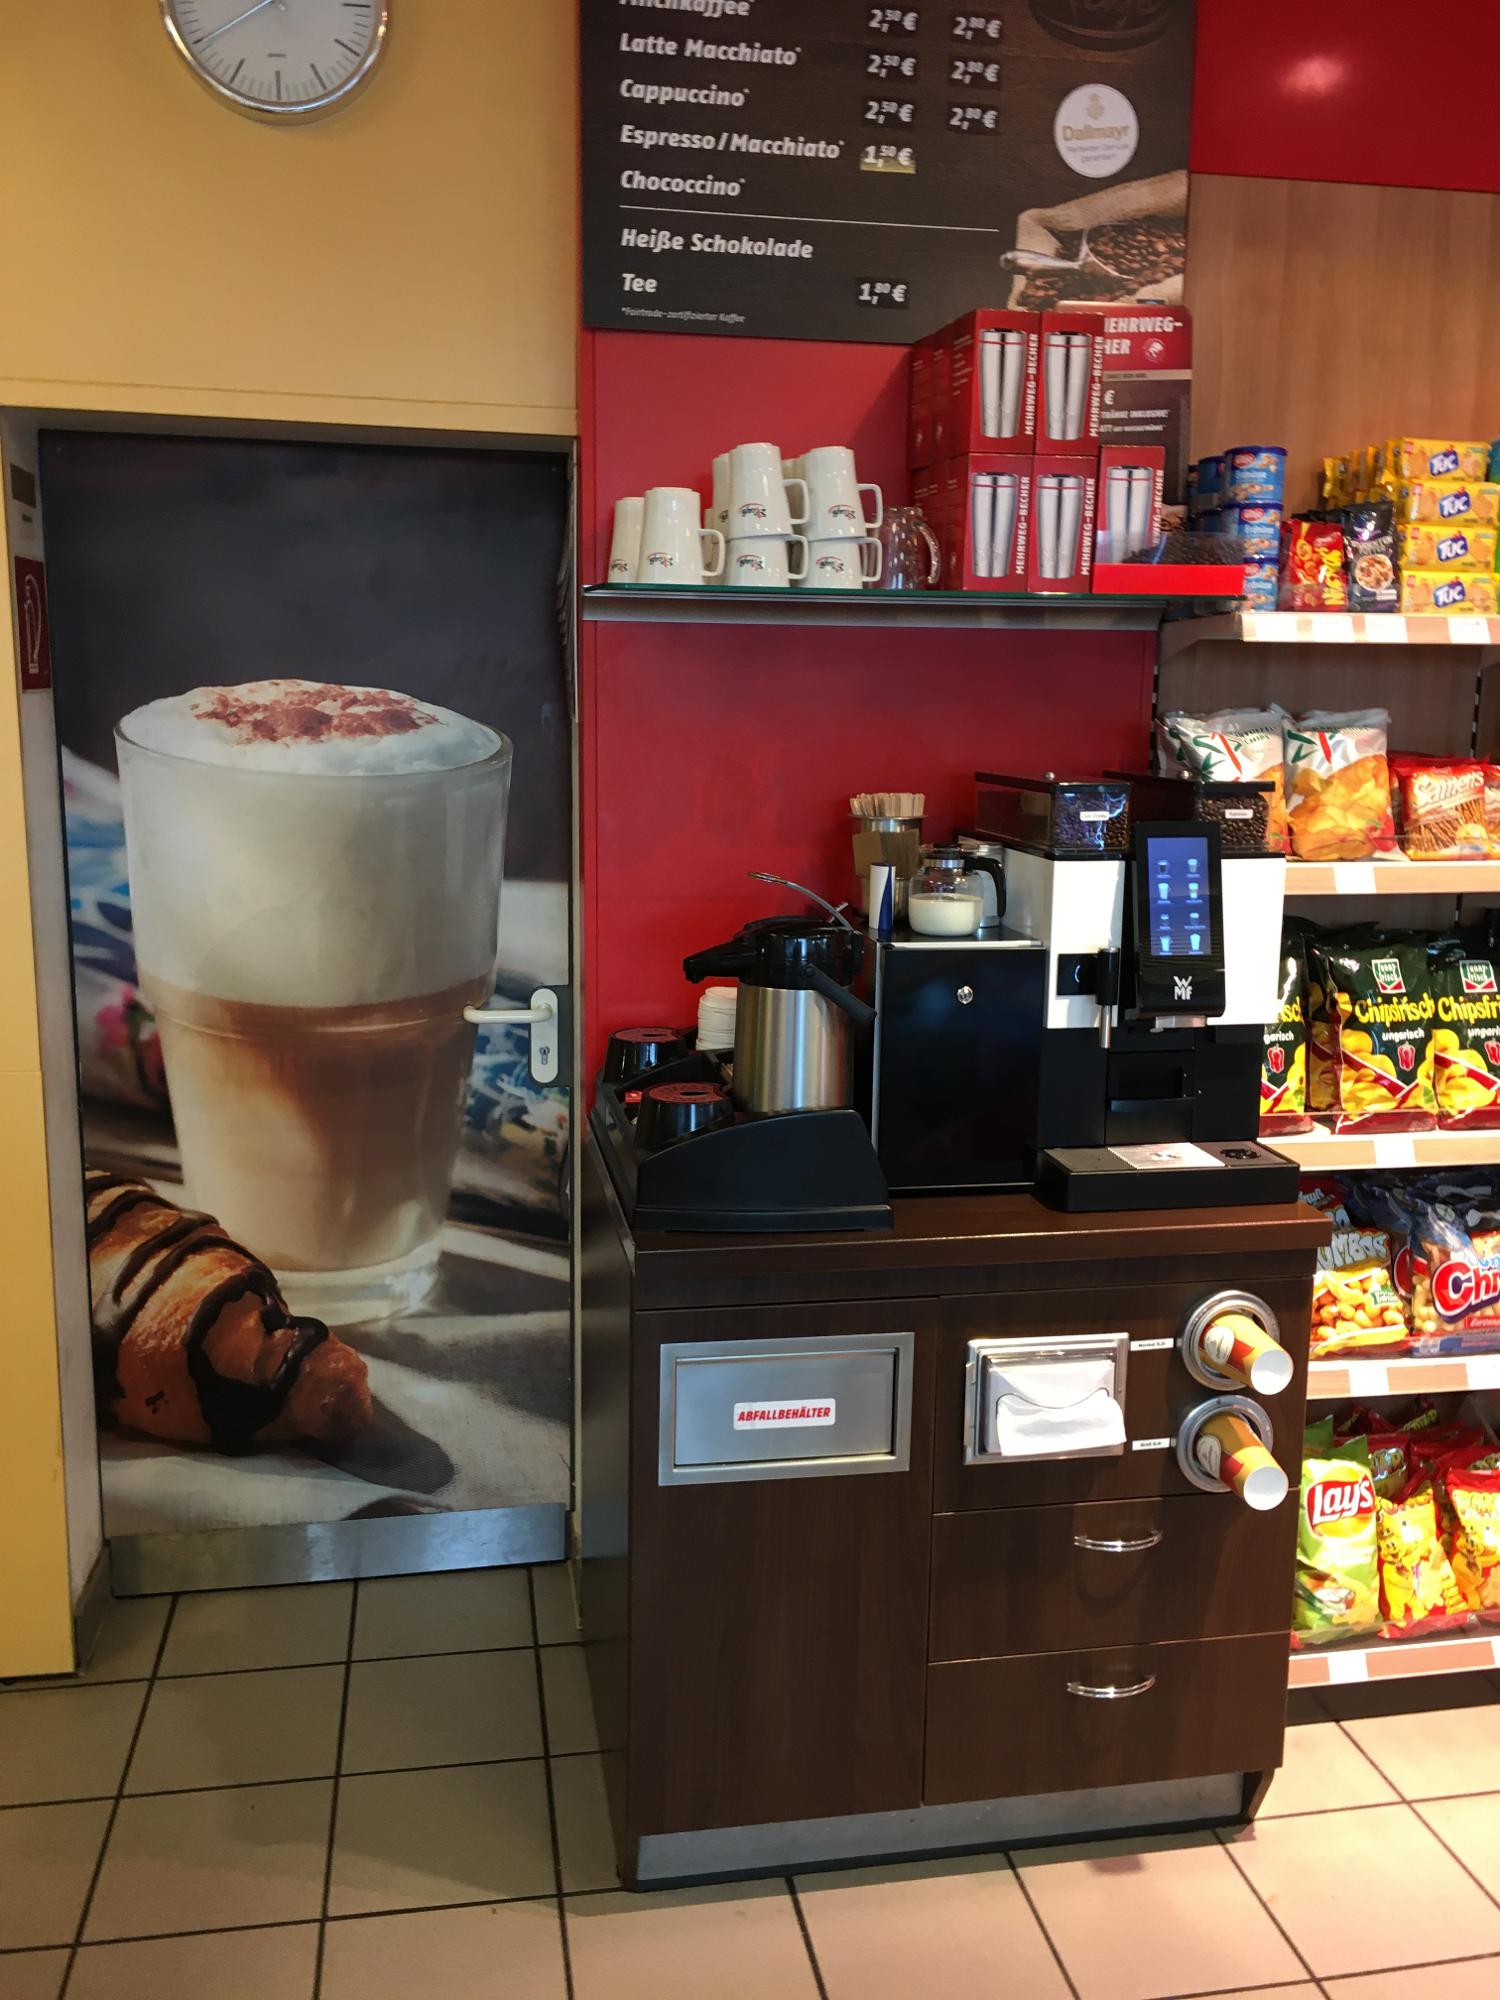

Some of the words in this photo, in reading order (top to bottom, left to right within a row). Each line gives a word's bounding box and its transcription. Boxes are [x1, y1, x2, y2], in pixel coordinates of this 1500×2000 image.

[620, 32, 678, 56] Latte
[1062, 124, 1130, 141] Dallmayr
[620, 228, 685, 253] Heiße
[690, 232, 814, 259] Schokolade
[621, 272, 658, 294] Tee
[1103, 338, 1131, 356] HER
[1024, 333, 1039, 436] MEHRWEG-BECHER
[1015, 476, 1031, 575] MEHRWEG-BECHER
[1080, 478, 1096, 576] MEHRWEG-BECHER
[1355, 991, 1436, 1027] Chipsfrisch
[1263, 1030, 1295, 1045] garisch
[1382, 1027, 1425, 1042] ungarisch
[1317, 1231, 1388, 1271] UMBOS
[737, 1406, 831, 1421] ABFALLBEHÄLTER
